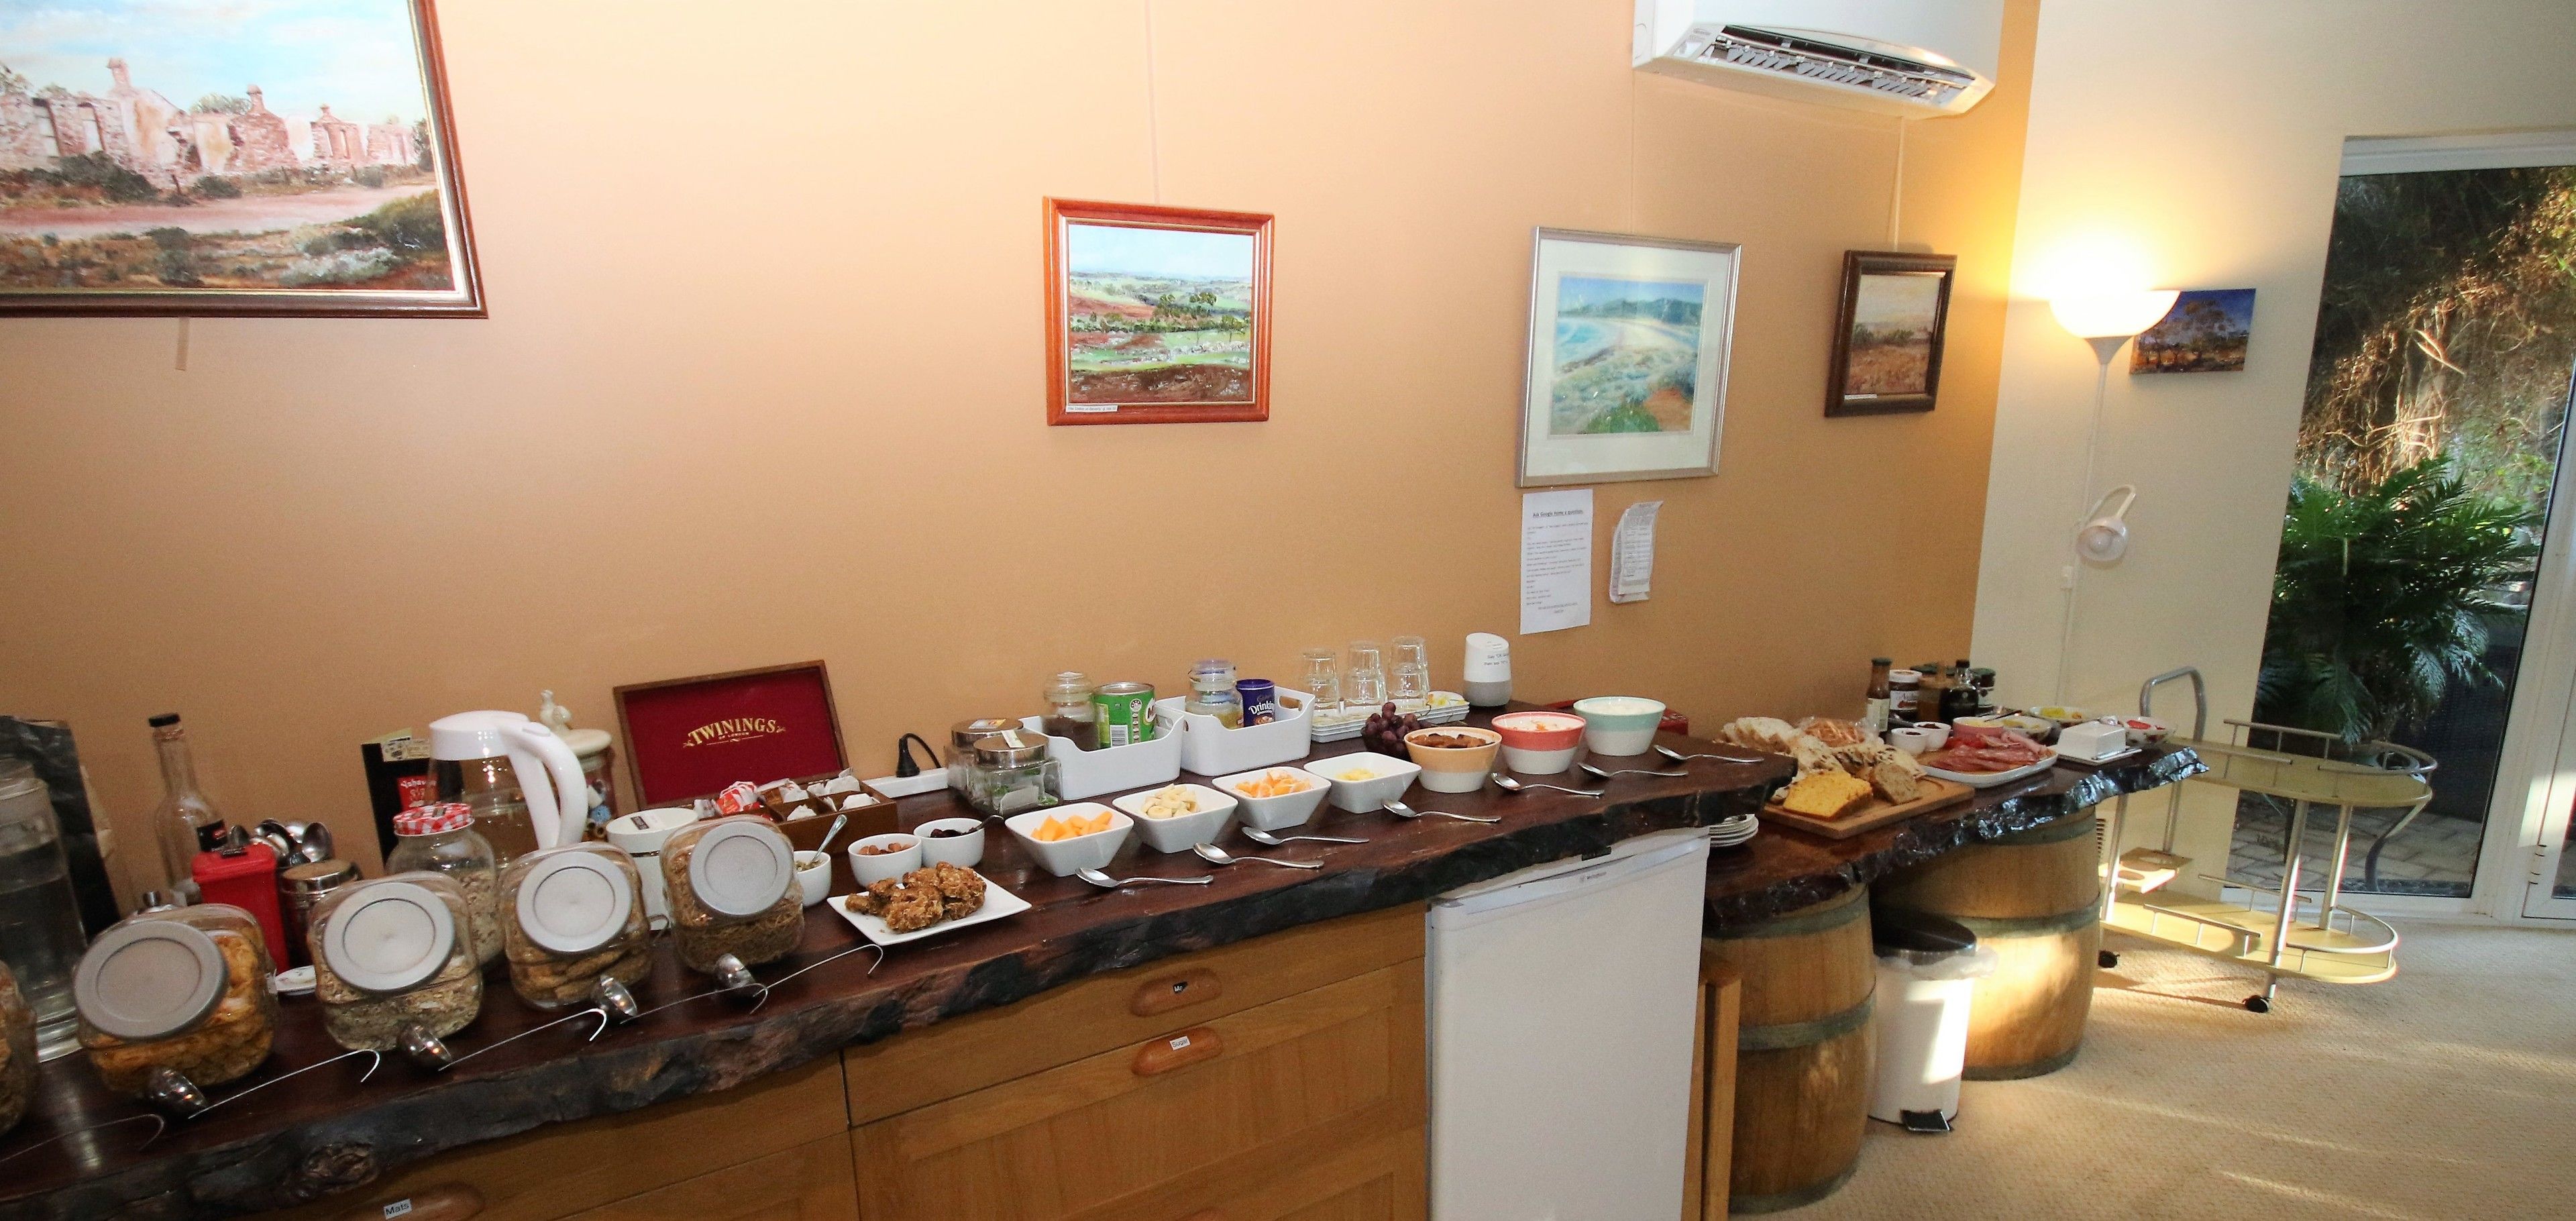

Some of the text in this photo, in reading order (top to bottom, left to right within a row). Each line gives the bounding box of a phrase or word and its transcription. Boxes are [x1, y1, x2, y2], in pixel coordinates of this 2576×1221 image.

[688, 717, 776, 745] TWININGS
[1171, 1038, 1189, 1048] Sugar
[385, 1203, 410, 1215] Mats
